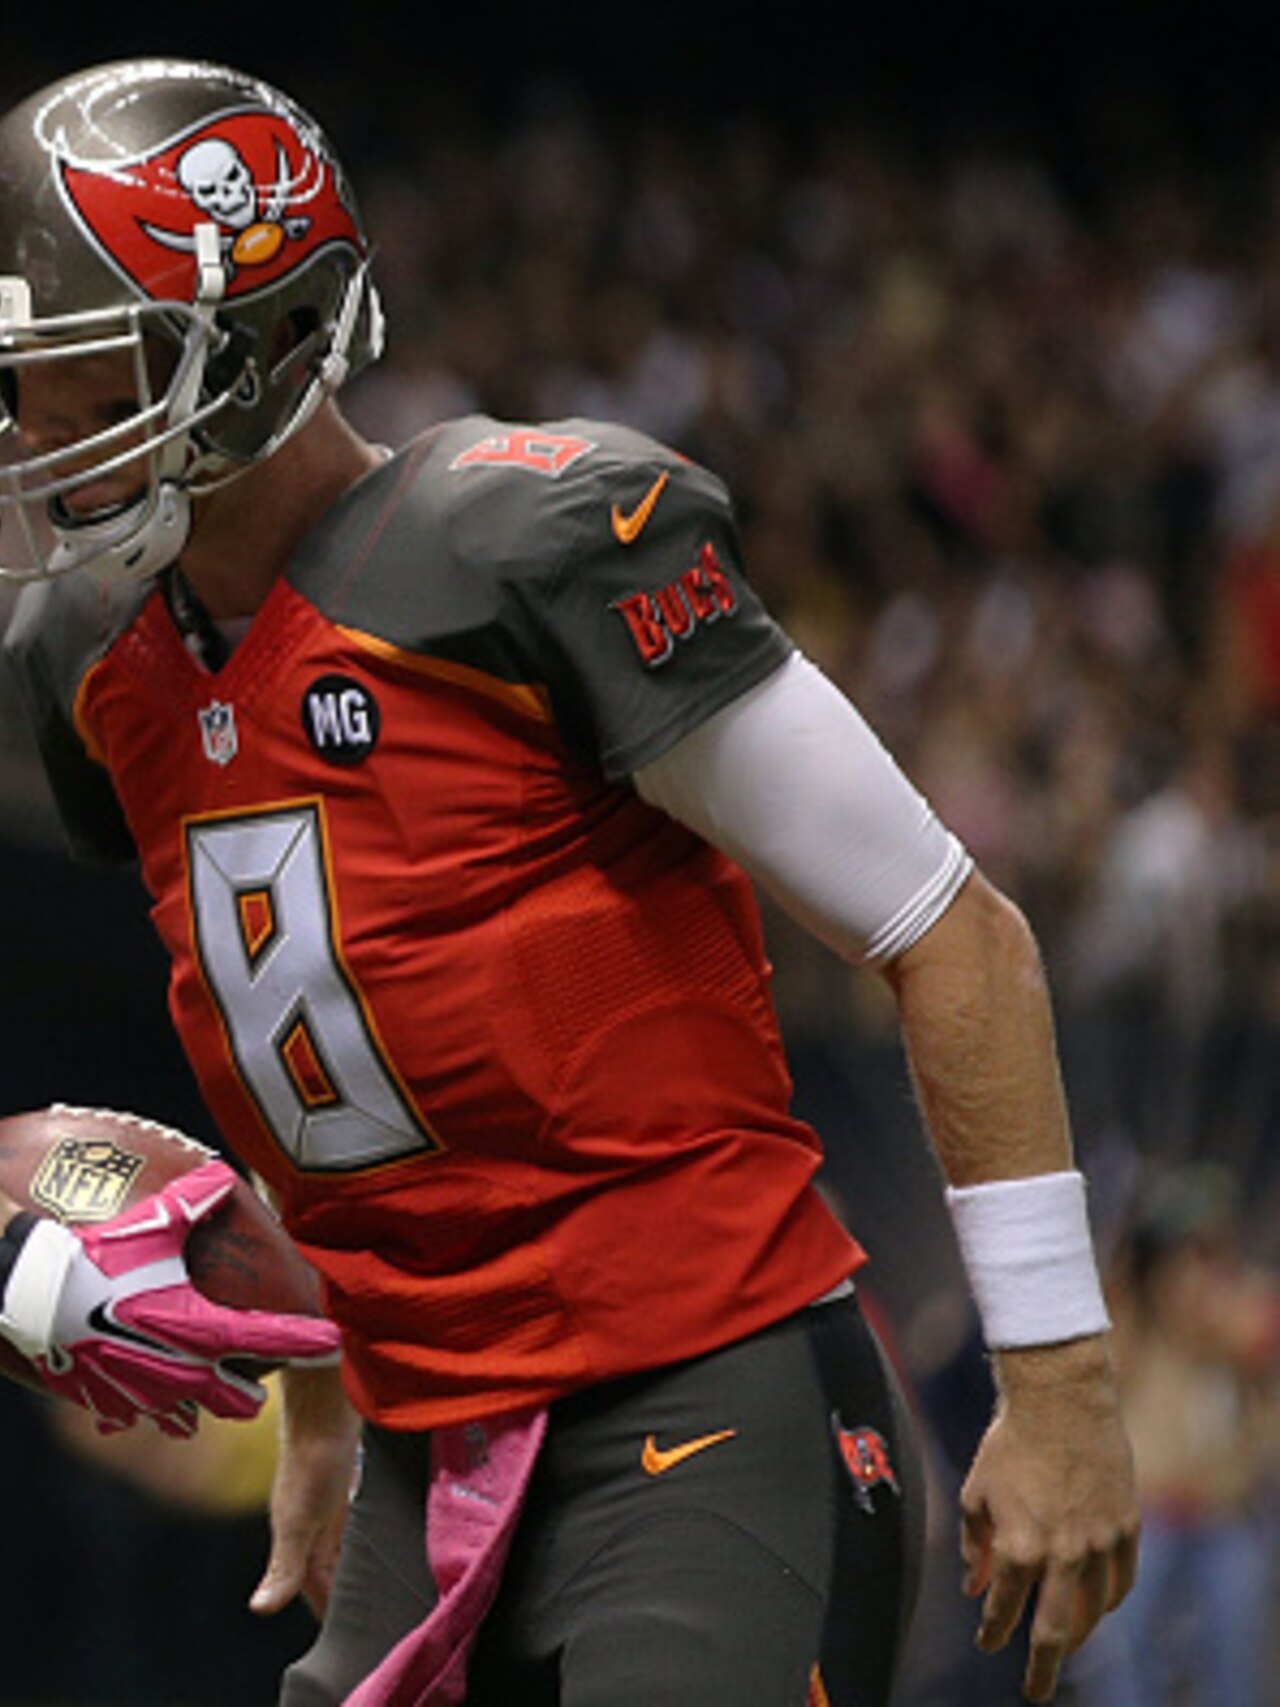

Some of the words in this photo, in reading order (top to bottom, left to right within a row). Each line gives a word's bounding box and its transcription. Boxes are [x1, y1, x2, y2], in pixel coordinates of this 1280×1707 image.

[608, 540, 738, 668] BUCS
[308, 688, 372, 748] MG
[181, 794, 447, 1180] 8
[41, 1160, 111, 1208] NFL
